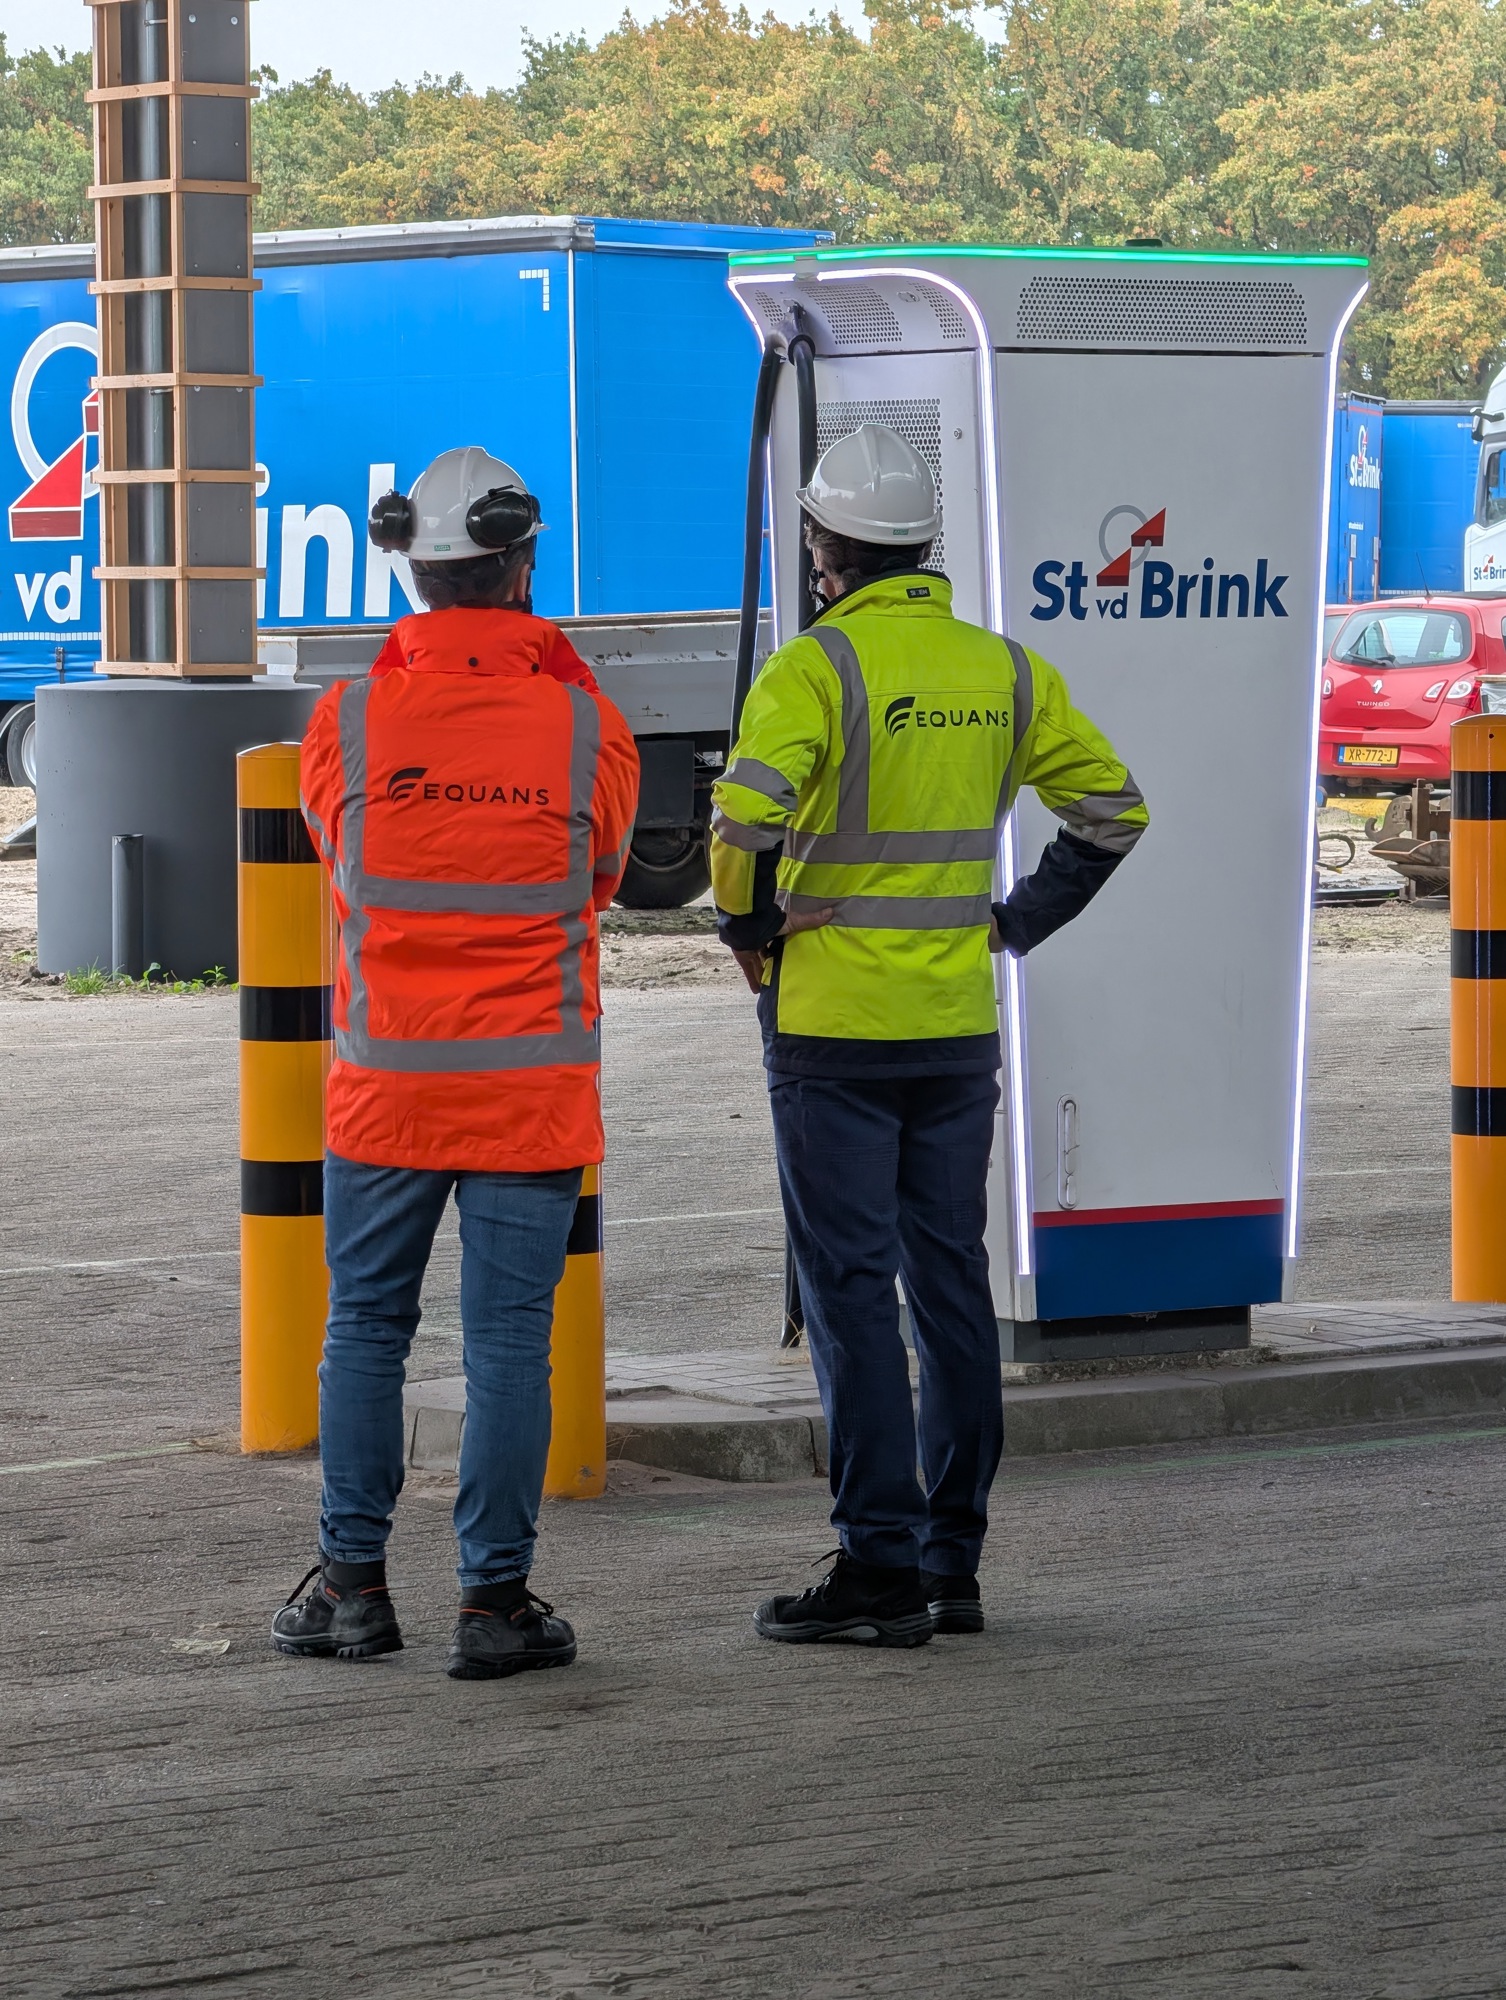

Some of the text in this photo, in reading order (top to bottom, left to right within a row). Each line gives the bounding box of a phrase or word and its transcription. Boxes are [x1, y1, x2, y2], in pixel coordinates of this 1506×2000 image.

[1349, 454, 1358, 487] St
[1363, 456, 1380, 490] Brink
[1473, 566, 1482, 580] St
[1490, 565, 1506, 580] Brin
[14, 555, 83, 624] vd
[1029, 557, 1289, 621] St vd Brink
[916, 709, 1009, 728] EQUANS
[1348, 748, 1393, 762] XR-772-J
[423, 783, 550, 806] EQUANS
